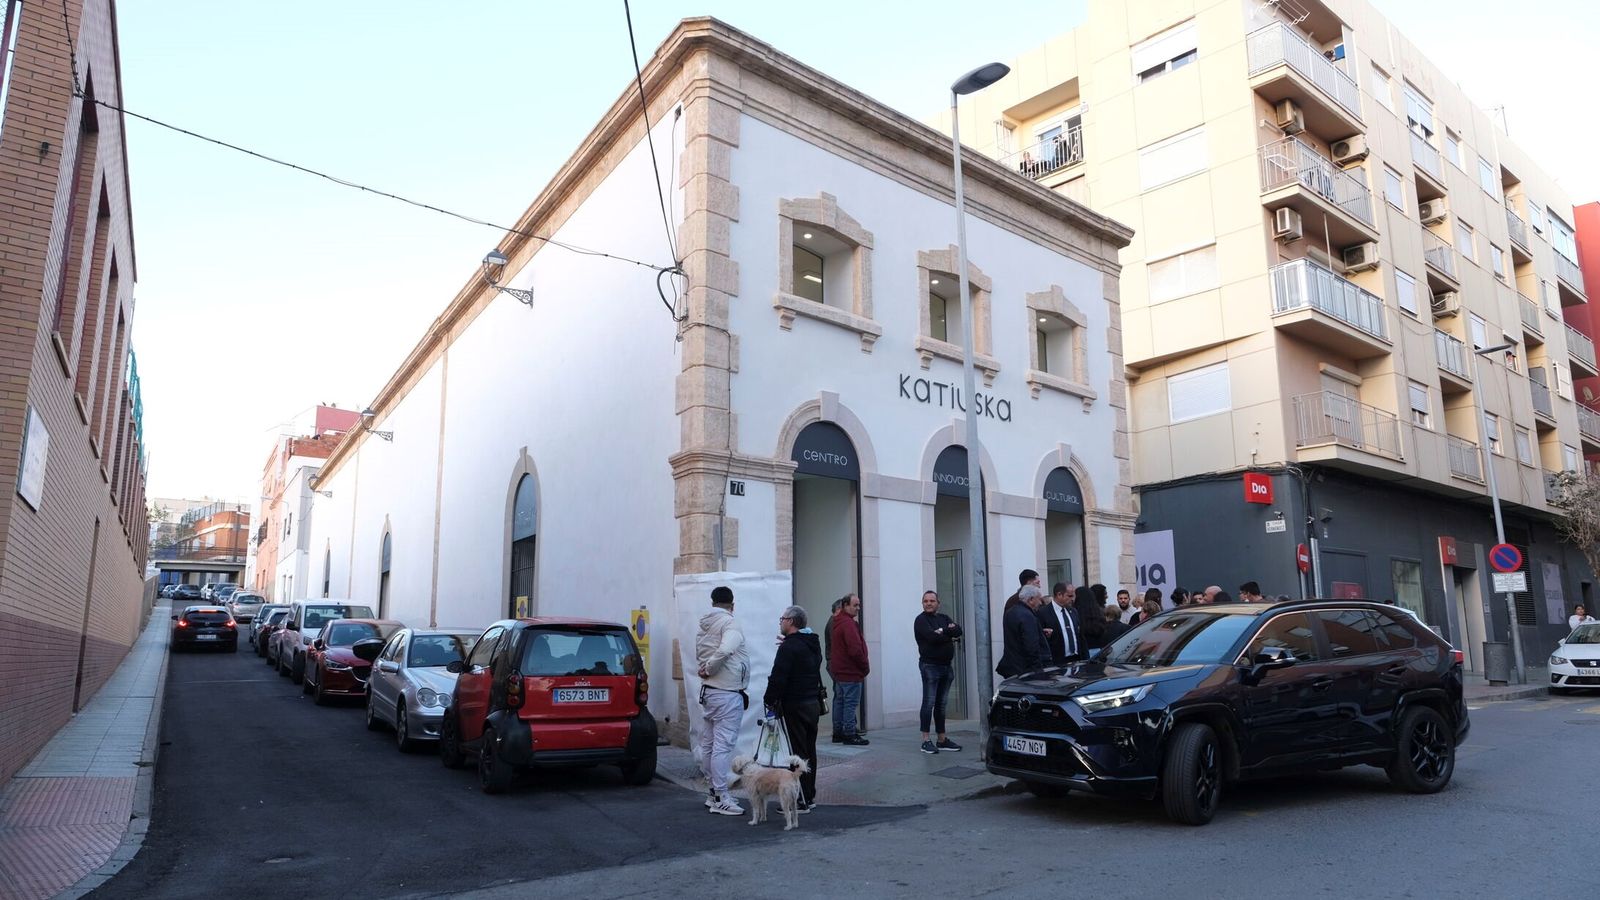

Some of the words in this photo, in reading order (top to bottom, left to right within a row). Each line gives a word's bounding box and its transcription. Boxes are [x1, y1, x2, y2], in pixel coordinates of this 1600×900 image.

[731, 481, 745, 495] 70
[559, 690, 585, 701] 6573
[588, 690, 606, 701] BNT
[1008, 738, 1027, 752] 4457
[1028, 741, 1044, 755] NGY
